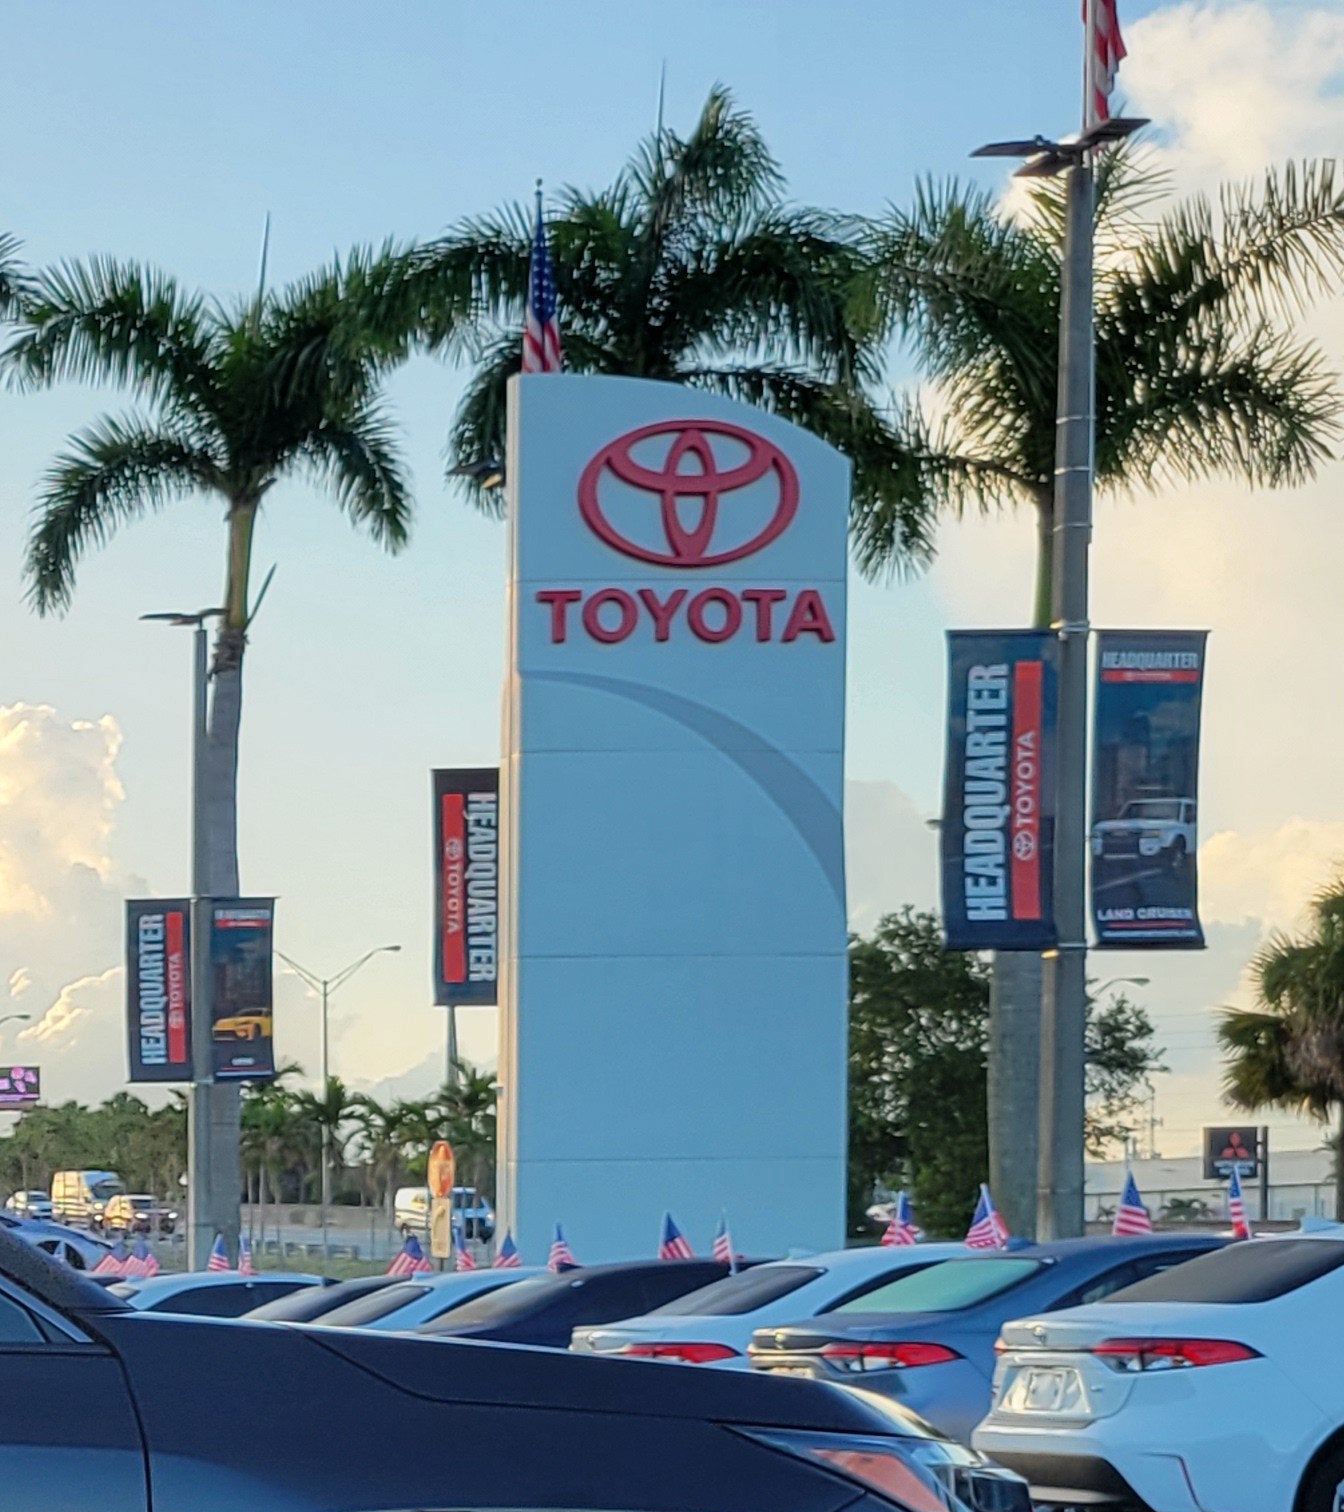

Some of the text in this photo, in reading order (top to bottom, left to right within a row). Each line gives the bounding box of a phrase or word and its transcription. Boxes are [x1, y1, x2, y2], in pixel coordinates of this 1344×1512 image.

[536, 588, 835, 643] TOYOTA
[965, 663, 1010, 920] HEADQUARTER
[1015, 731, 1036, 828] TOYOTA
[447, 862, 461, 934] TOYOTA
[465, 793, 496, 981] HEADQUARTER
[139, 914, 168, 1065] HEADQUARTER
[168, 953, 181, 1010] TOYOTA
